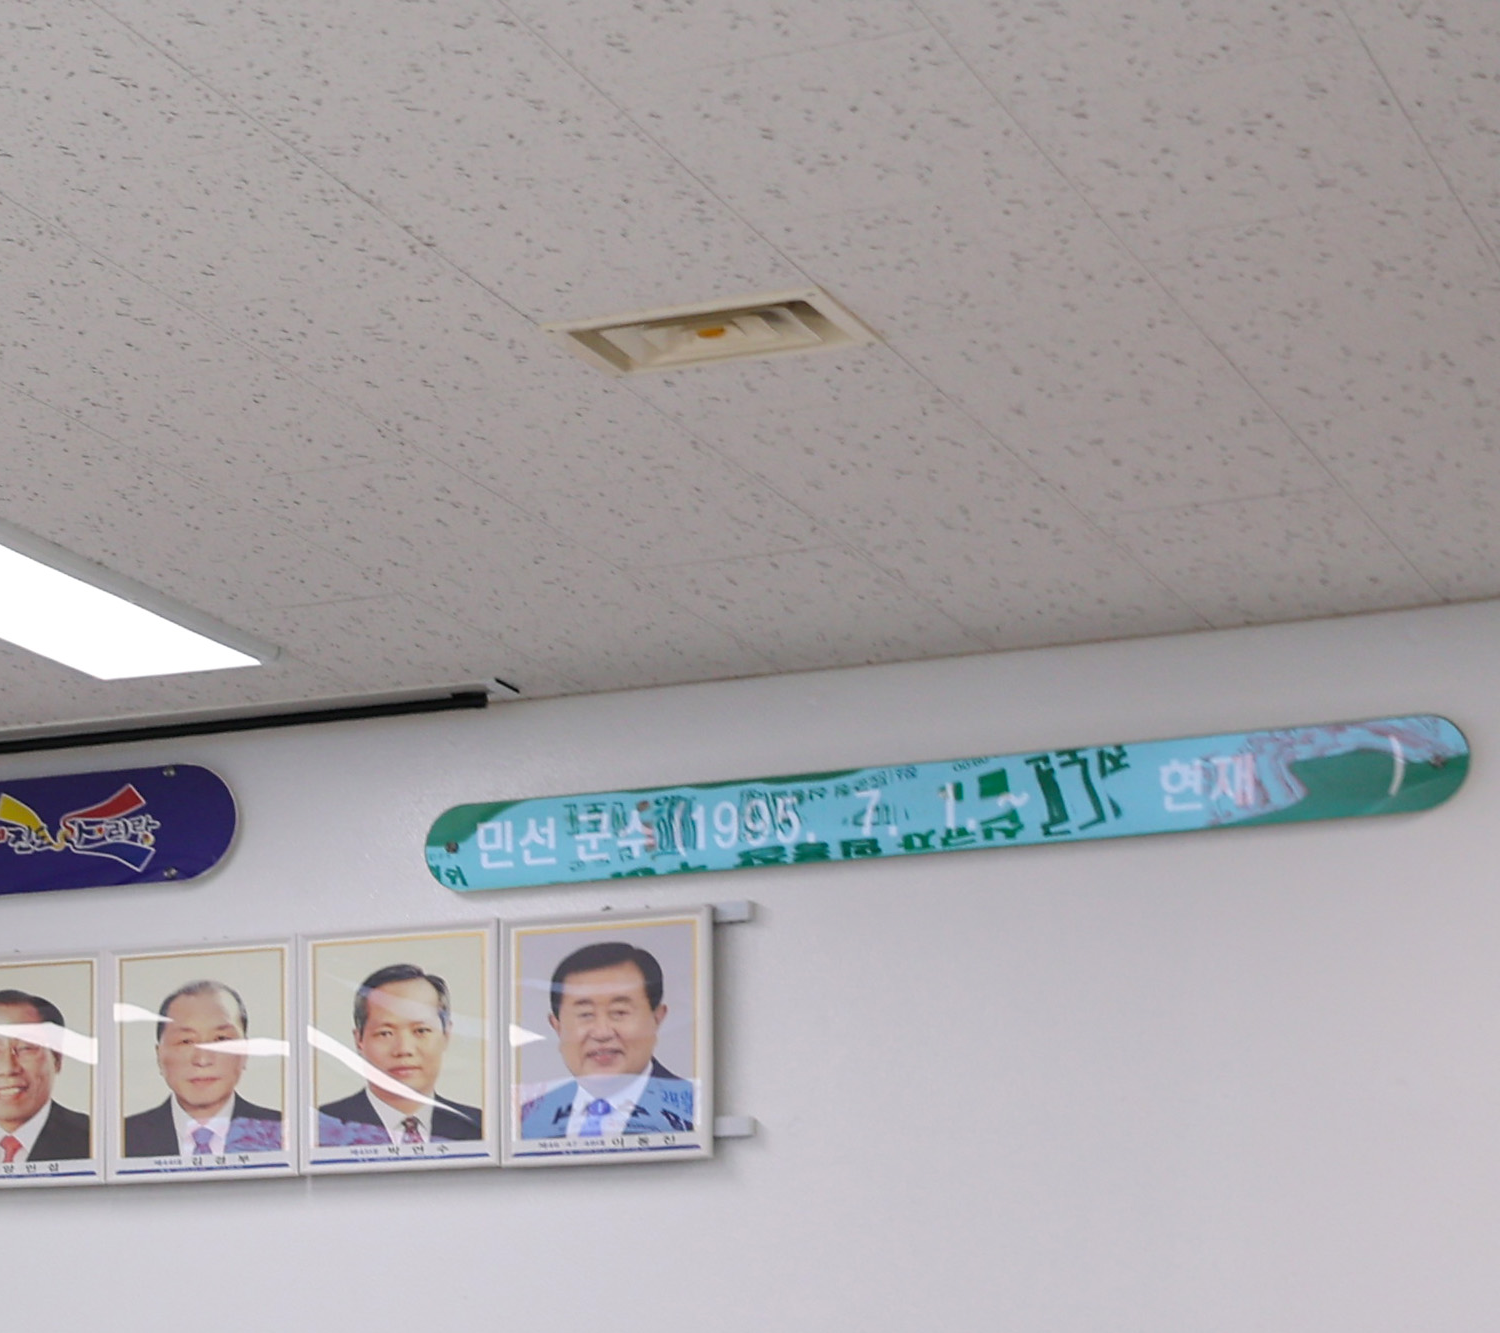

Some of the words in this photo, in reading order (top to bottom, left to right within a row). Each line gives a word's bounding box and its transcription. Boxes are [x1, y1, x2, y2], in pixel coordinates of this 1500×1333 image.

[476, 817, 557, 869] 민선
[573, 814, 654, 864] 군수
[853, 787, 898, 836] 7.
[1159, 753, 1256, 811] 현재
